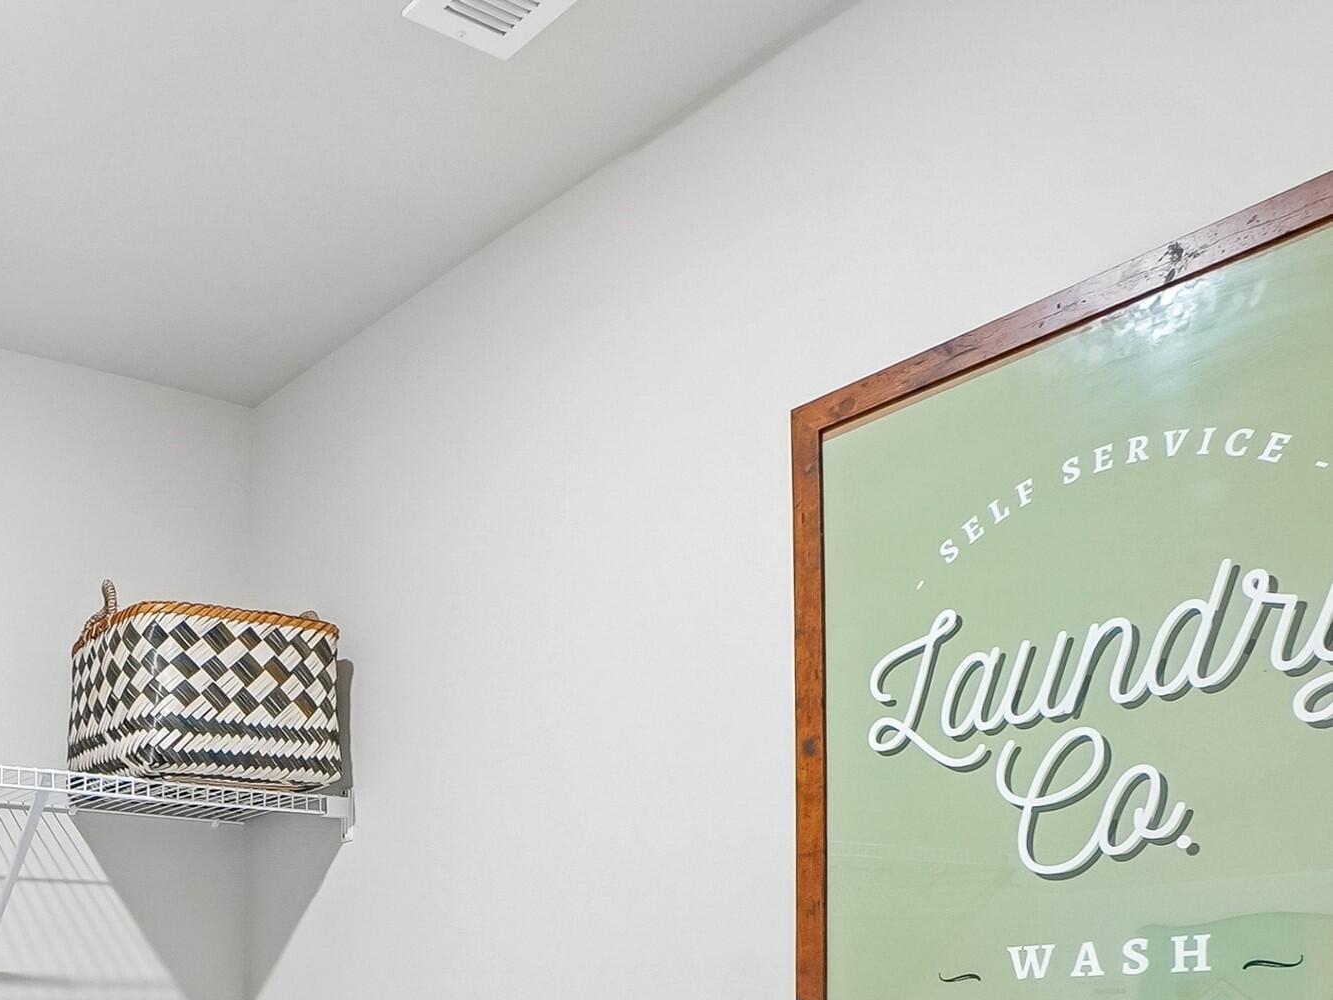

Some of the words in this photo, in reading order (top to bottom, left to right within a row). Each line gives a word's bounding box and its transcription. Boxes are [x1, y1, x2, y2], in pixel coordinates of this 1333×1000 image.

[938, 476, 1035, 565] SELF
[1061, 426, 1294, 486] SERVICE
[996, 726, 1194, 875] Co.
[1006, 932, 1213, 981] WASH
